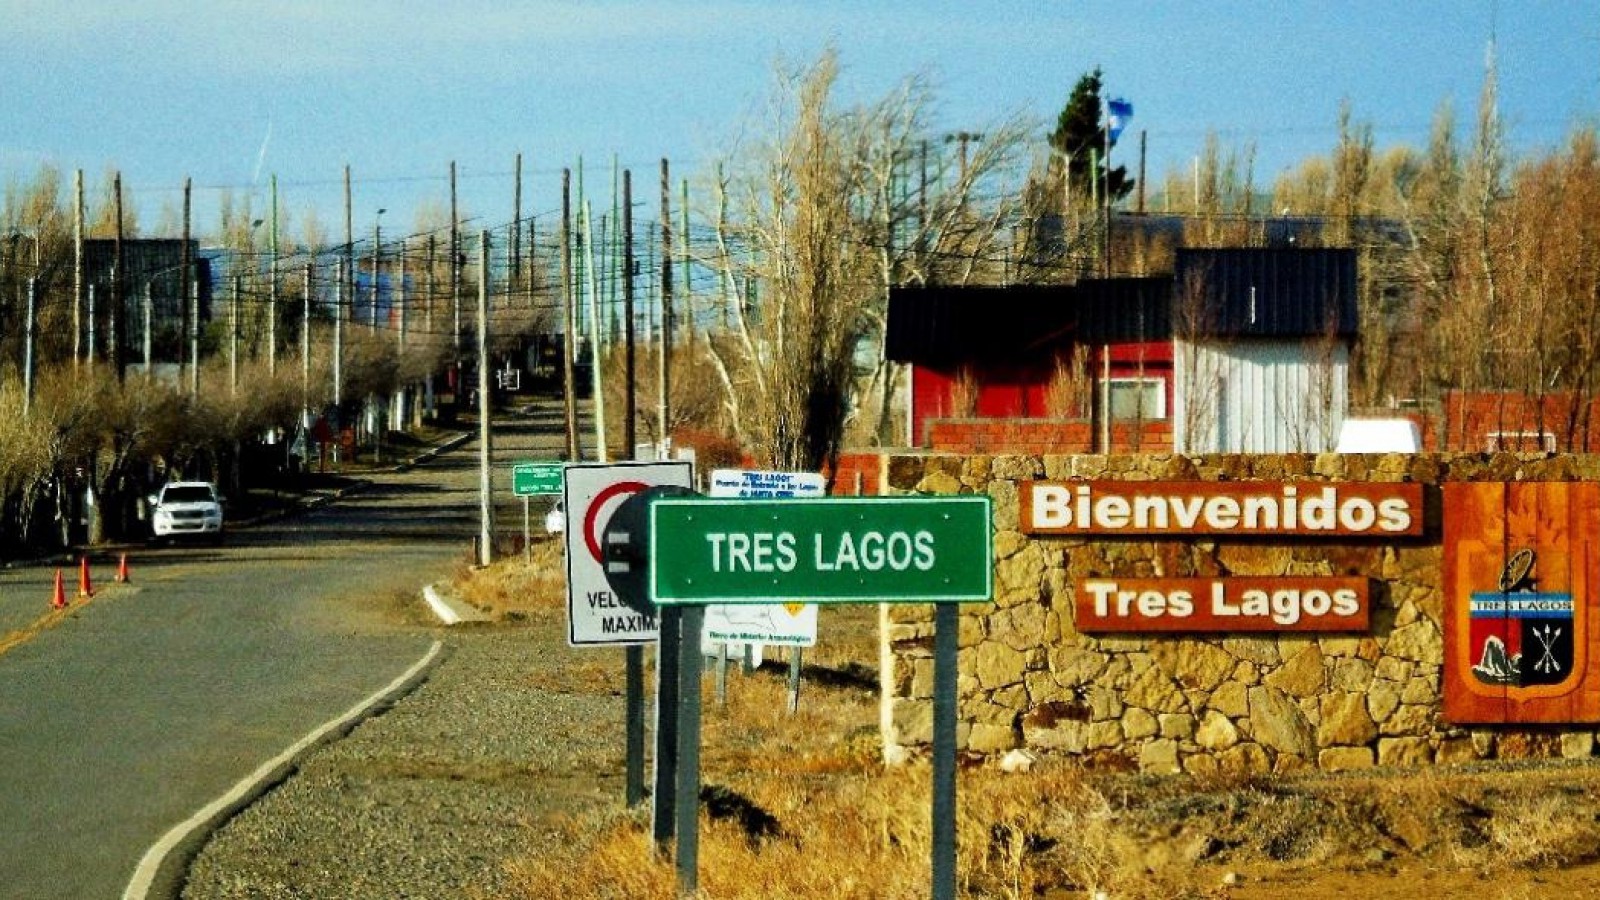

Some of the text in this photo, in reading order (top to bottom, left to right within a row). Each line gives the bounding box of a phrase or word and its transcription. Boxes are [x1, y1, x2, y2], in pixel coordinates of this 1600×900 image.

[1032, 485, 1412, 532] Bienvenidos
[706, 531, 935, 573] TRES LAGOS
[1085, 582, 1359, 624] Tres Lagos
[1477, 601, 1572, 611] TRES LAGOS
